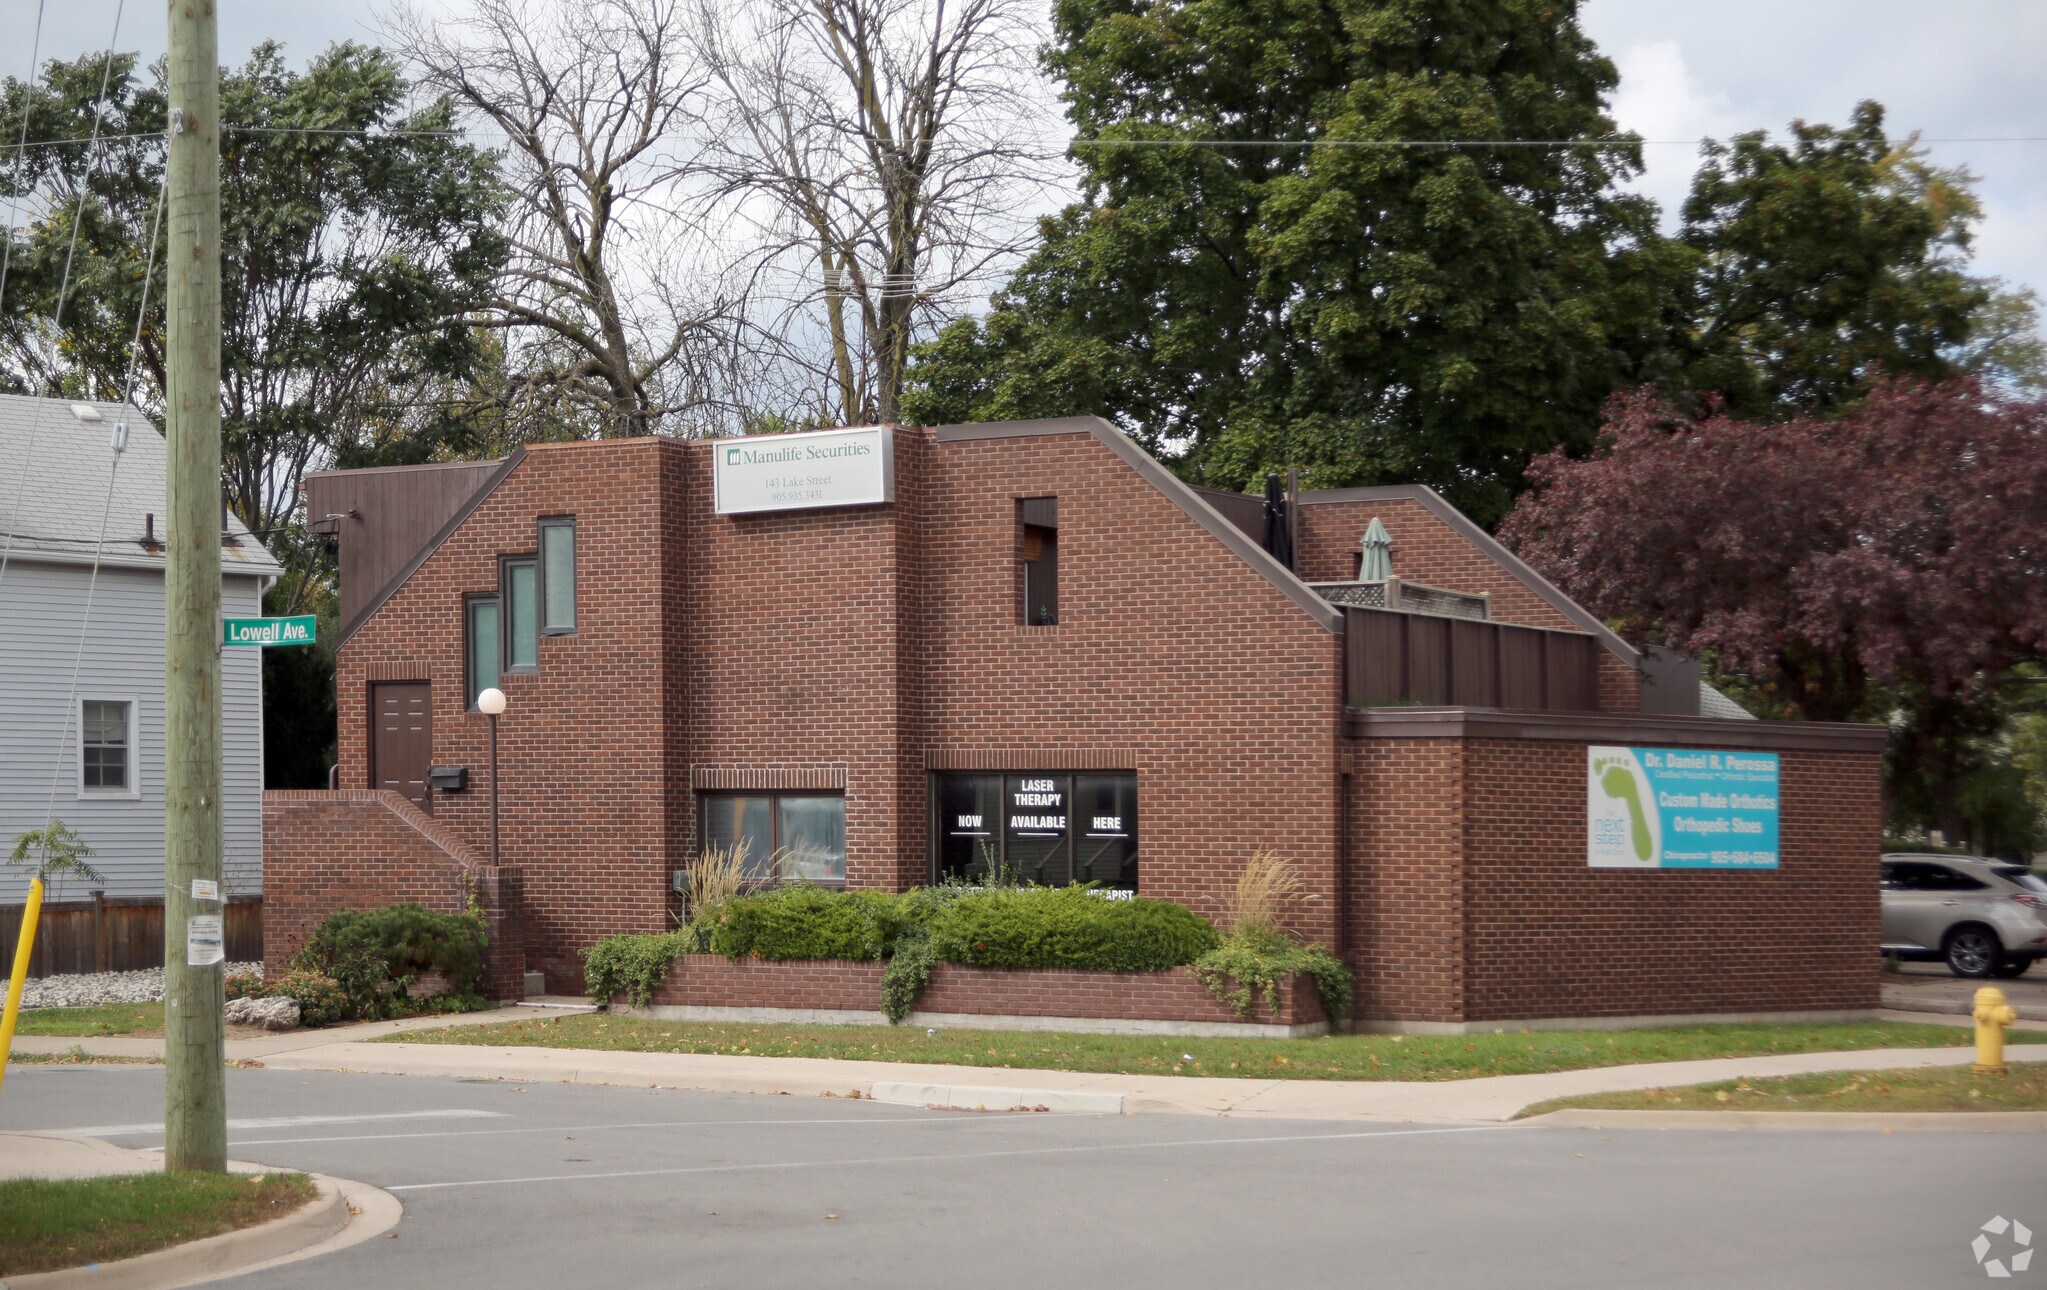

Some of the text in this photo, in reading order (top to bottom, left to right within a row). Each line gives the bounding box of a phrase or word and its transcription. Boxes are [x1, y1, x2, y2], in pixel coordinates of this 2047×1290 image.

[744, 442, 870, 464] Manulife Securities
[765, 475, 832, 489] 143 Lake Street
[230, 622, 308, 640] Lowell Ave.
[1645, 752, 1776, 771] Dr. Daniel R. Perossa
[1021, 779, 1054, 792] LASER
[1014, 793, 1061, 806] THERAPY
[1659, 791, 1776, 810] Custom Made Orthotics
[958, 815, 1121, 829] NOW AVAILABLE HERE
[1594, 817, 1625, 832] next
[1673, 816, 1763, 835] Orthopedic Shoes
[1594, 833, 1625, 848] step
